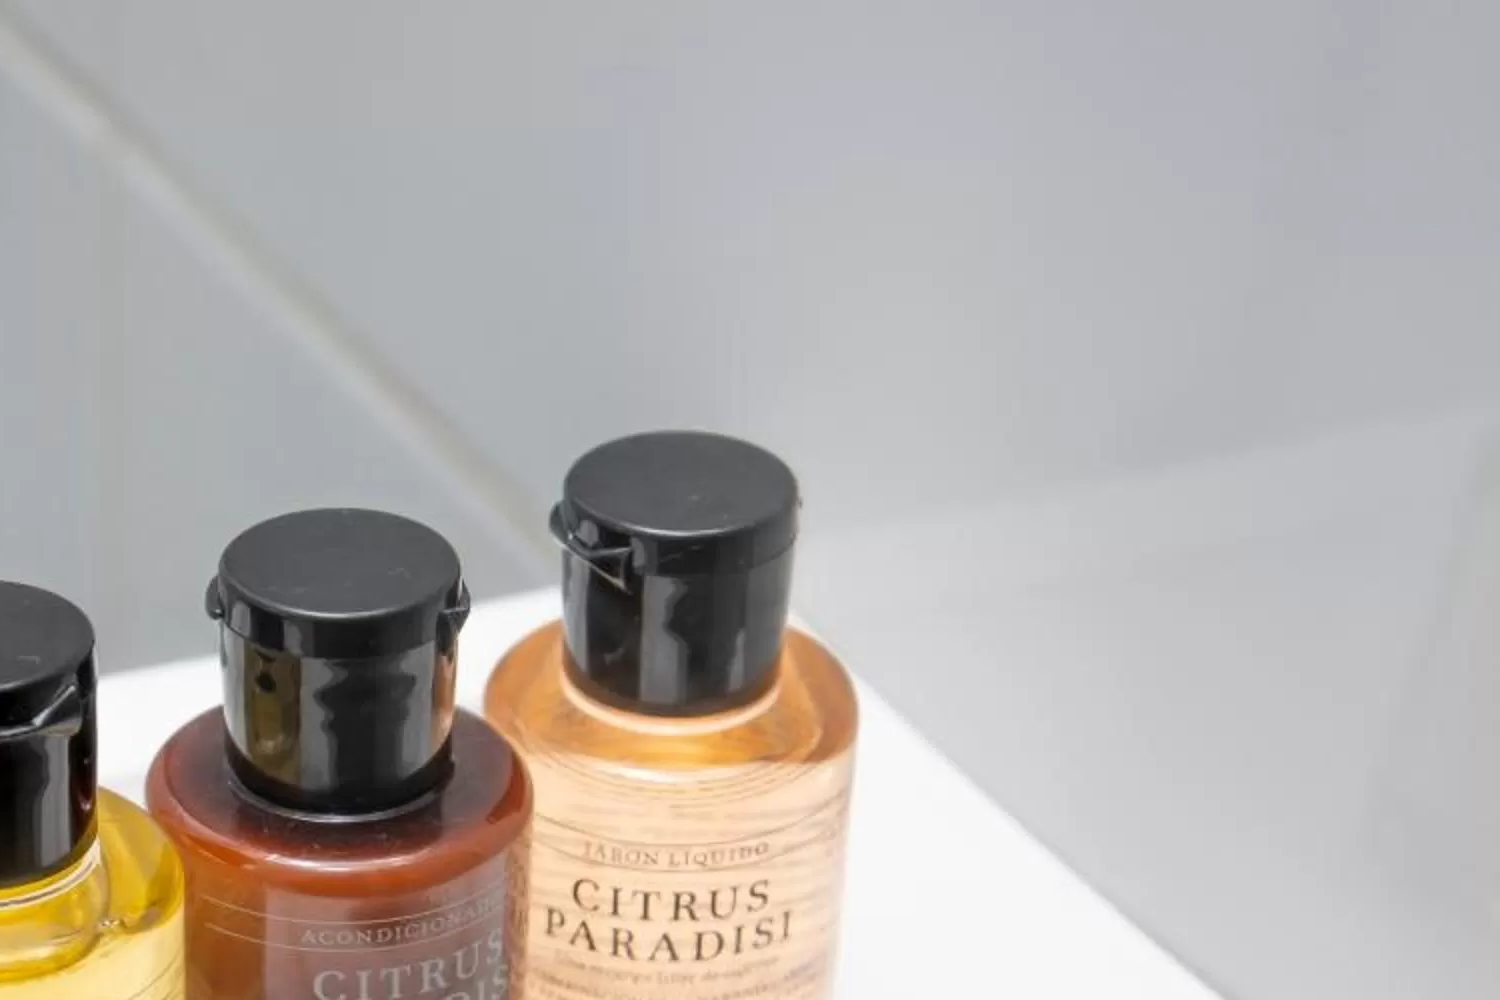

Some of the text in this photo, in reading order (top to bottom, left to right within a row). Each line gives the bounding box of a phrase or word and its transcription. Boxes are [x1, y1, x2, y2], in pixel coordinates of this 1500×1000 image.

[301, 898, 498, 946] ACONDICIONAD
[572, 878, 770, 922] CITRUS
[543, 905, 792, 962] PARADISI
